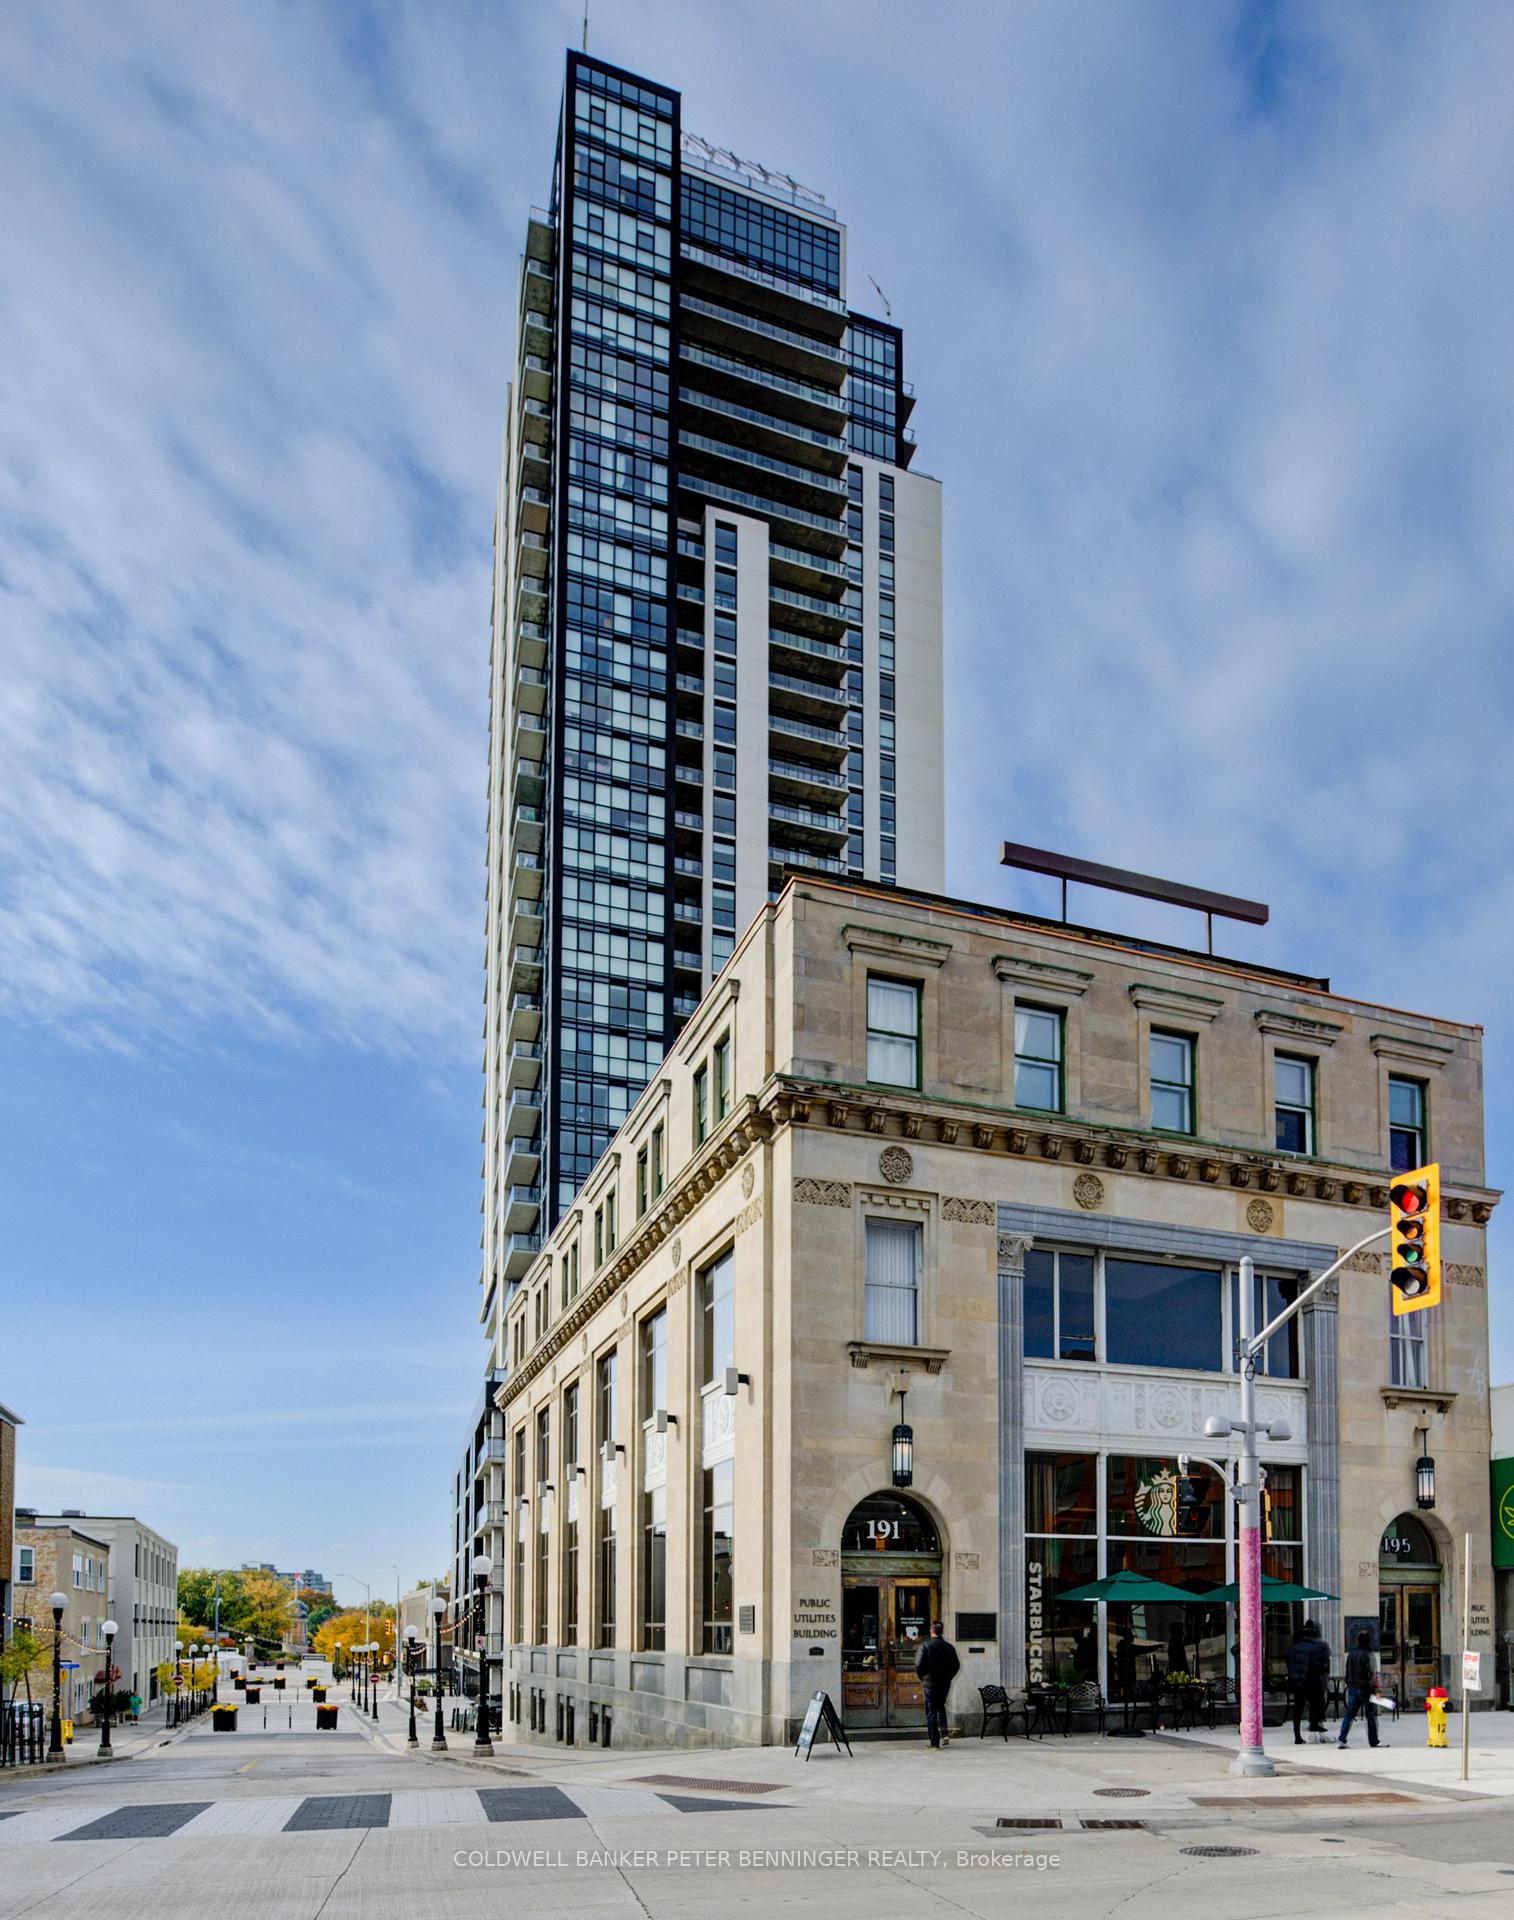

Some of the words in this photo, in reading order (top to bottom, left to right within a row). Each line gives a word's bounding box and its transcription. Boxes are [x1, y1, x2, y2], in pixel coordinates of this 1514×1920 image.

[866, 1519, 901, 1539] 191
[1383, 1537, 1411, 1553] 195
[799, 1598, 831, 1608] PUBLIC
[794, 1613, 837, 1623] UTILITIES
[1029, 1561, 1043, 1684] STARBUCKS
[793, 1629, 837, 1639] BUILDING
[1437, 1723, 1447, 1734] 12
